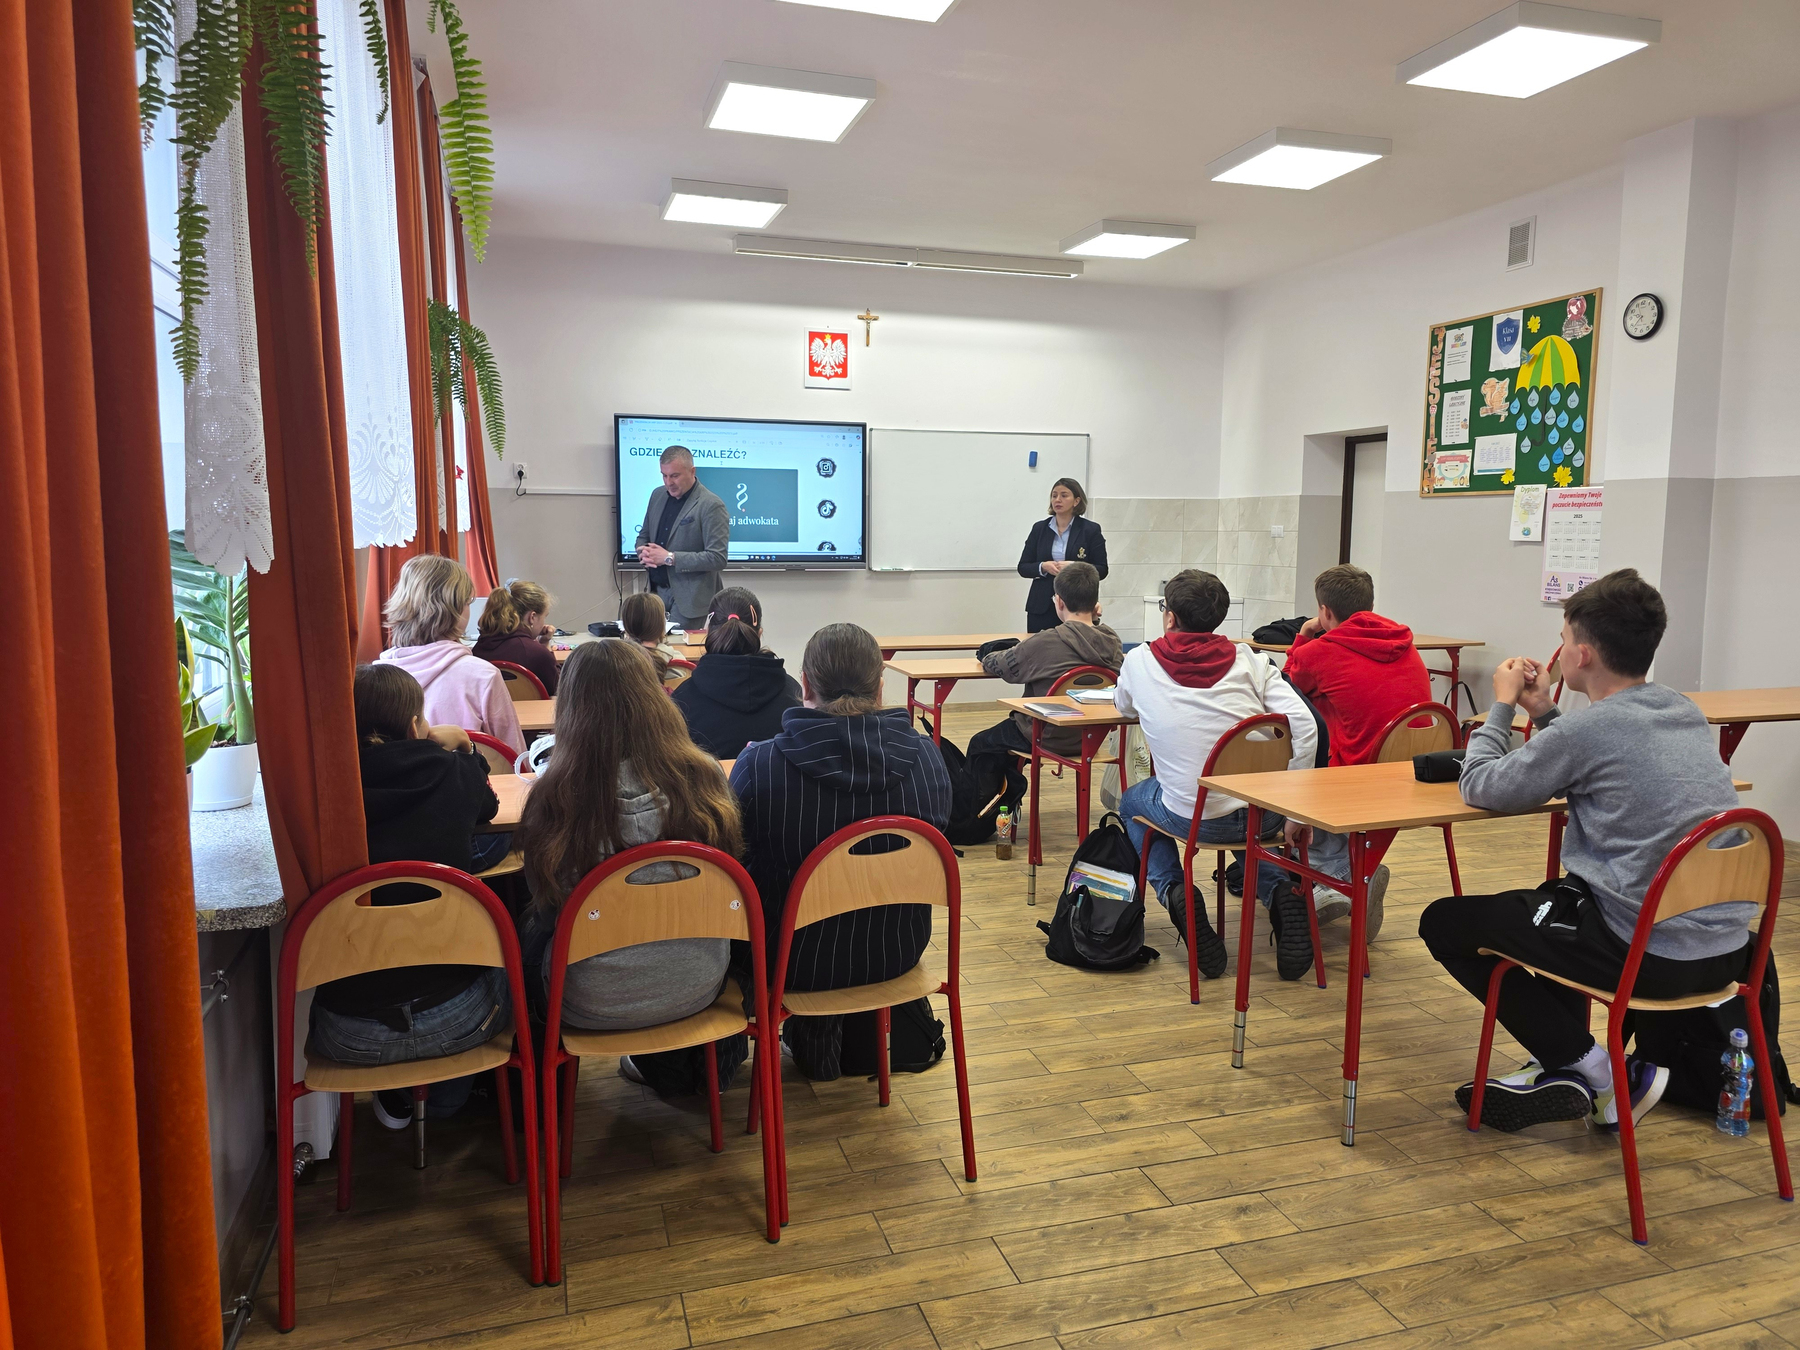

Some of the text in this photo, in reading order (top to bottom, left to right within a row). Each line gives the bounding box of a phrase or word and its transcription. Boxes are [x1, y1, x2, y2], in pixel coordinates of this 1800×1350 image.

[629, 447, 662, 457] GDZIE
[691, 448, 747, 459] ZNALEŹĆ?
[1521, 486, 1540, 494] Dyplom
[1588, 491, 1602, 499] Twoje
[738, 515, 779, 525] adwokata
